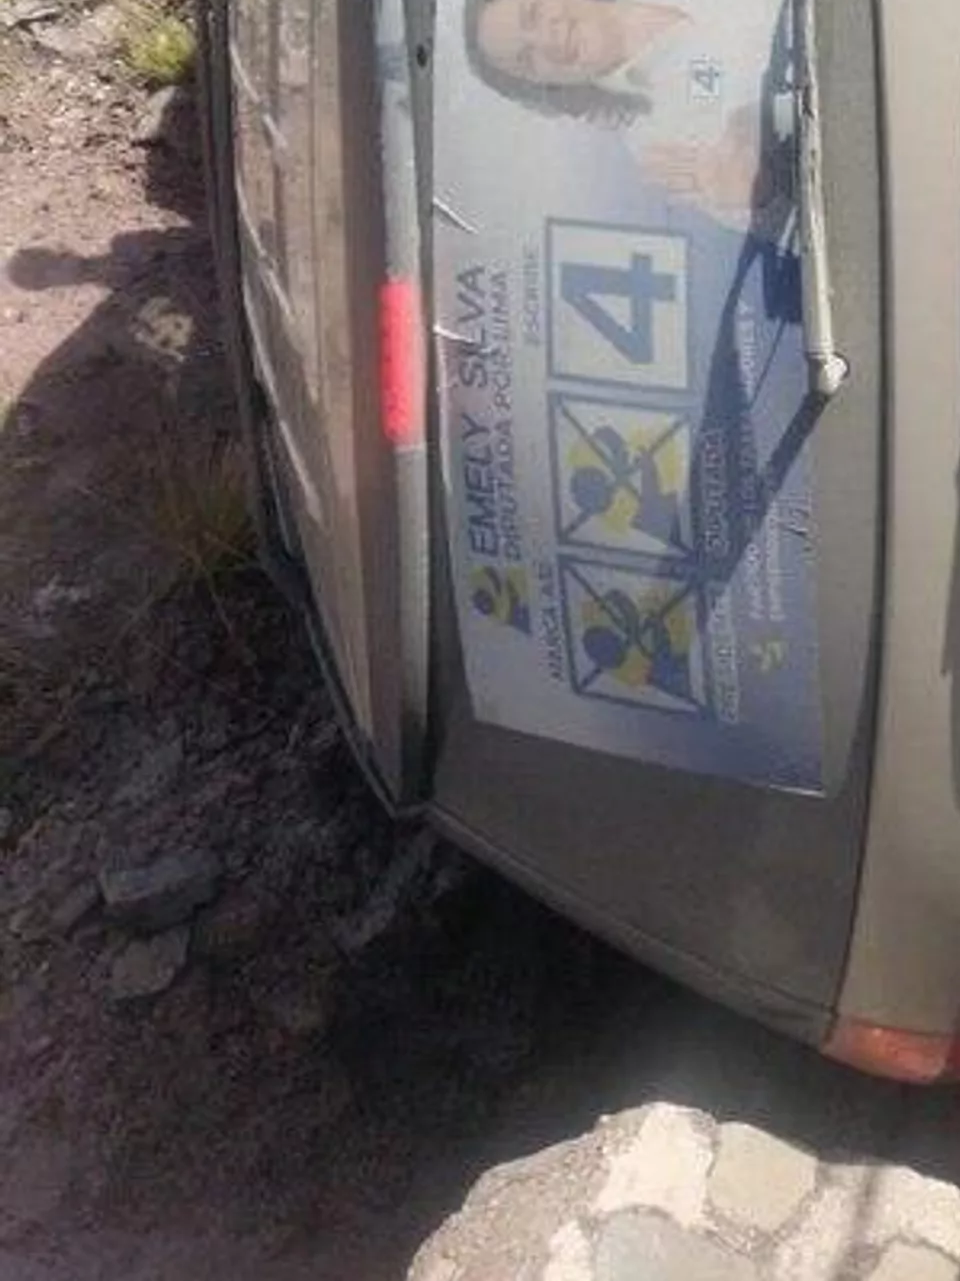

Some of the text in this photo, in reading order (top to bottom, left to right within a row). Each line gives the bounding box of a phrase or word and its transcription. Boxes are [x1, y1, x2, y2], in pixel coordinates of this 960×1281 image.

[692, 66, 720, 93] 4
[561, 253, 677, 365] 4
[458, 265, 499, 558] EMELY SILVA
[494, 349, 512, 412] POR
[493, 418, 522, 562] DIPUTADA
